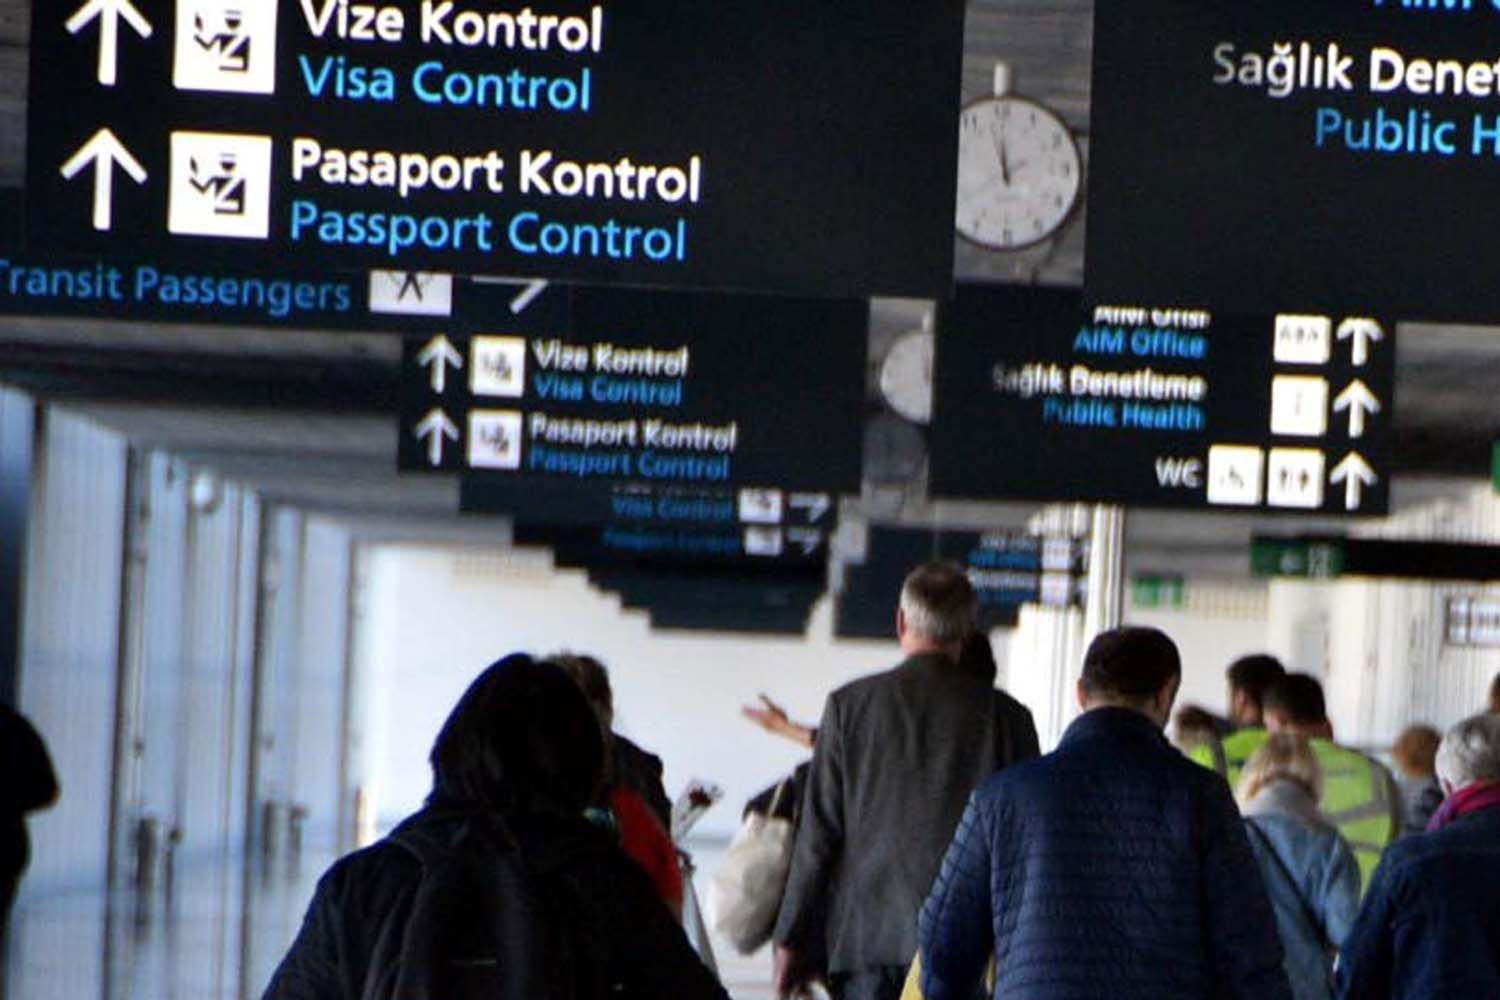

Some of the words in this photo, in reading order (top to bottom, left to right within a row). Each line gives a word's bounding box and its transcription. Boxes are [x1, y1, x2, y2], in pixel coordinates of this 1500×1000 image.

[300, 0, 405, 42] Vize
[420, 0, 603, 53] Kontrol
[300, 55, 396, 101] Visa
[412, 61, 592, 111] Control
[1213, 41, 1353, 97] Sağlık
[1315, 107, 1456, 156] Public
[292, 137, 505, 198] Pasaport
[519, 149, 701, 203] Kontrol
[291, 200, 493, 257] Passport
[508, 211, 687, 261] Control
[135, 266, 351, 318] Passengers
[593, 342, 689, 377] Kontrol
[1074, 328, 1126, 355] AIM
[1130, 329, 1207, 360] Office
[590, 377, 683, 407] Control
[642, 418, 738, 452] Kontrol
[1043, 398, 1117, 428] Public
[1121, 402, 1206, 431] Health
[636, 450, 731, 479] Control
[1155, 457, 1203, 489] WC
